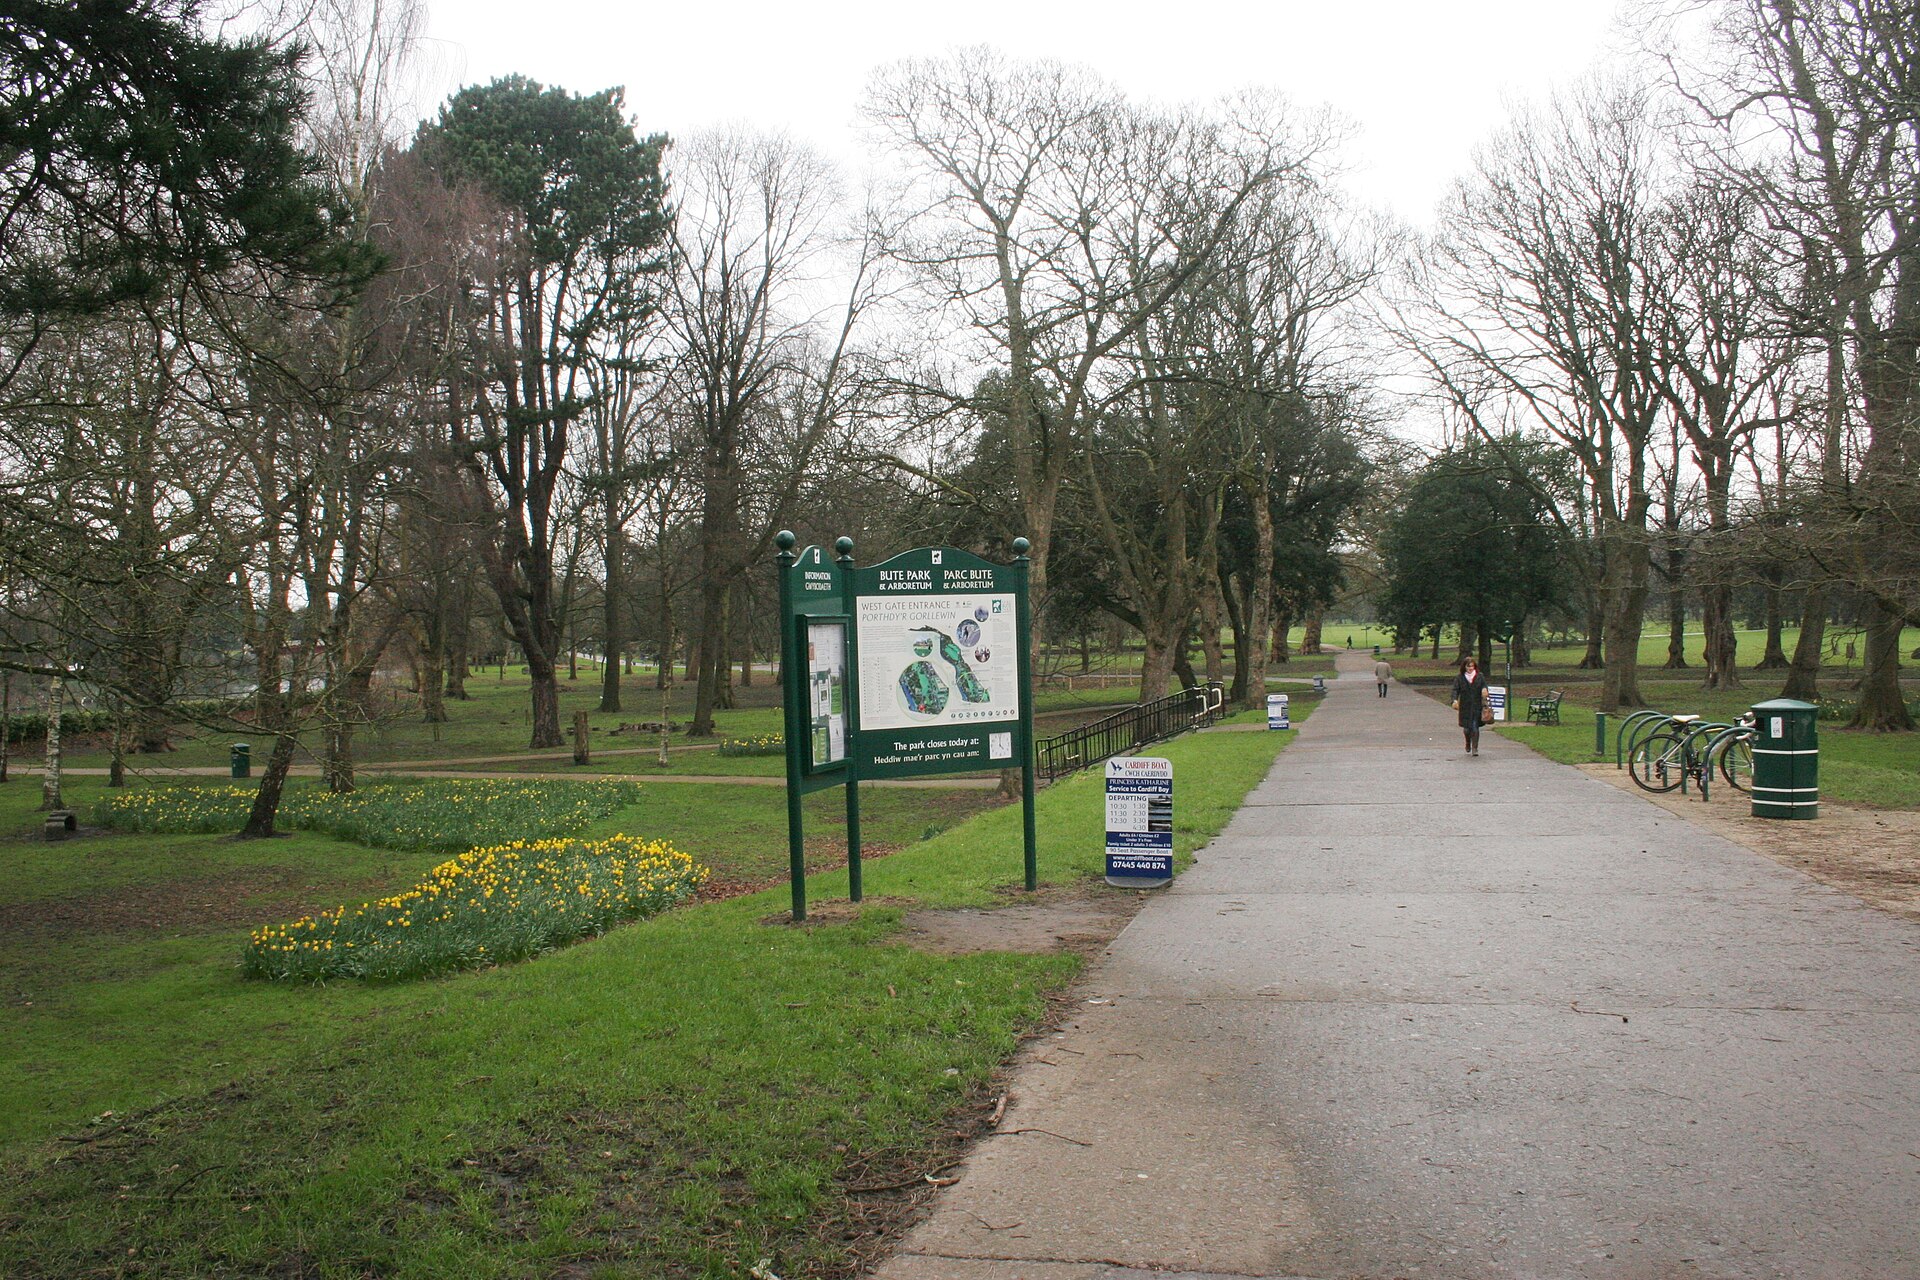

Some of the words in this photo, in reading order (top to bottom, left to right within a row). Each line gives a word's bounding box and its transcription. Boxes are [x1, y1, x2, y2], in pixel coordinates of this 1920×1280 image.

[880, 570, 904, 580] BUTE
[906, 570, 930, 580] PARK
[944, 570, 968, 580] PARC
[970, 570, 992, 579] BUTE
[888, 582, 932, 590] ARBORETUM
[950, 580, 994, 589] ARBORETUM
[862, 602, 882, 610] WEST
[884, 602, 906, 610] GATE
[908, 600, 950, 610] ENTRANCE
[910, 612, 956, 620] GORLLEWIN
[894, 742, 908, 750] The
[910, 740, 925, 751] park
[926, 739, 948, 748] closes
[948, 738, 968, 747] today
[874, 756, 902, 764] Heddiw
[904, 754, 923, 762] mae'r
[924, 754, 940, 762] parc
[1125, 761, 1150, 769] CARDIFF
[1152, 762, 1167, 770] BOAT
